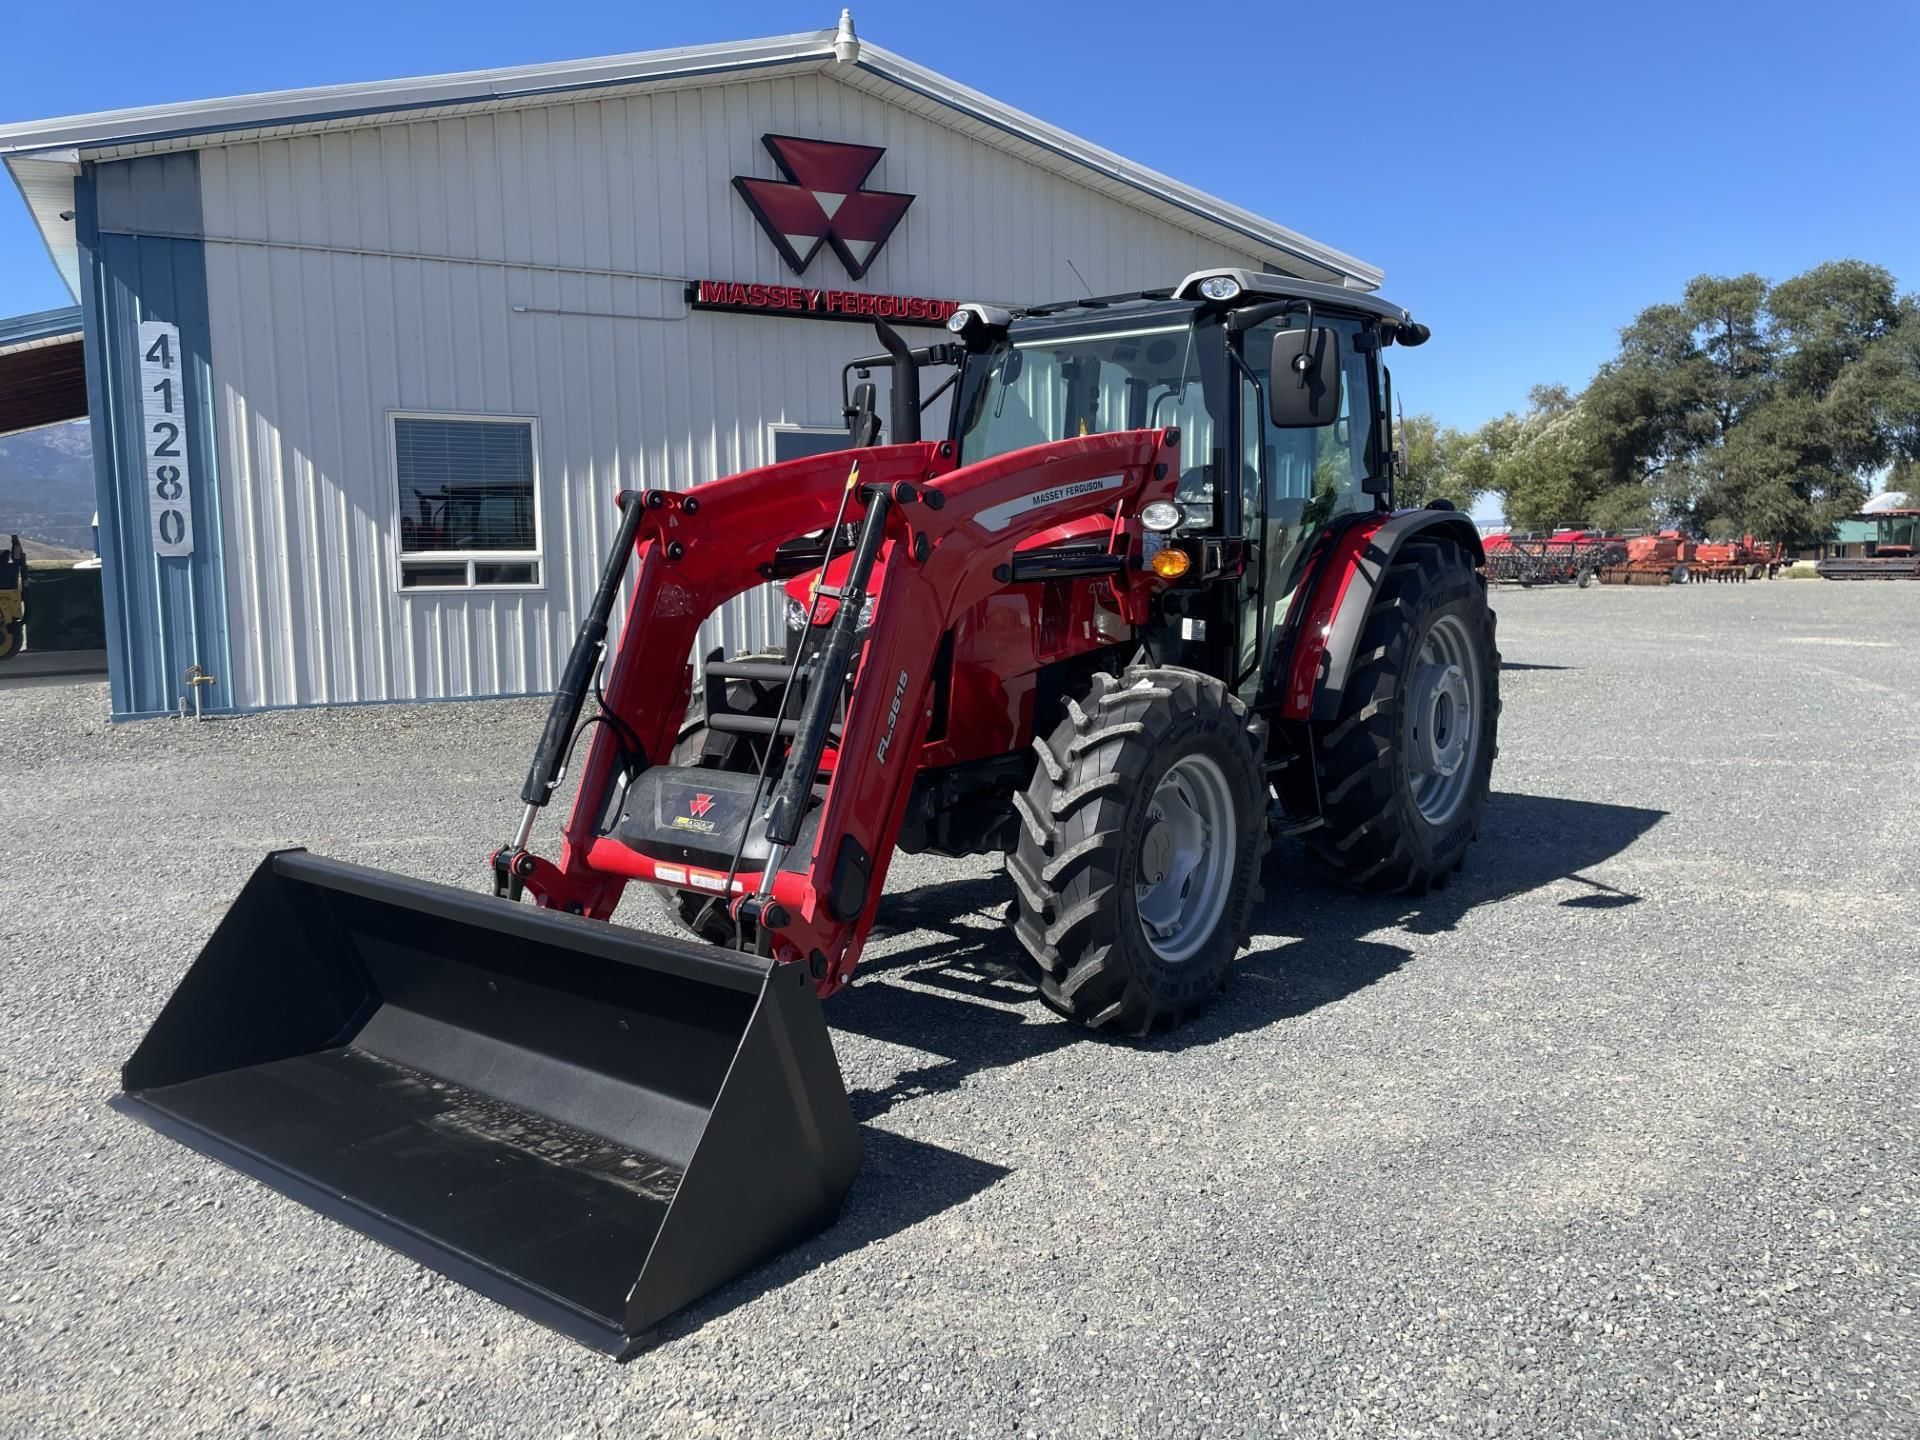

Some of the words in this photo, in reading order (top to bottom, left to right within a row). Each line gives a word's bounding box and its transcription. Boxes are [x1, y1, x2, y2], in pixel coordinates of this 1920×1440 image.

[700, 280, 820, 311] MASSEY
[826, 290, 960, 321] FERGUSON
[146, 333, 186, 545] 41280
[1032, 488, 1064, 506] MASSEY
[1065, 480, 1104, 497] FERGUSON
[1088, 580, 1111, 595] 471
